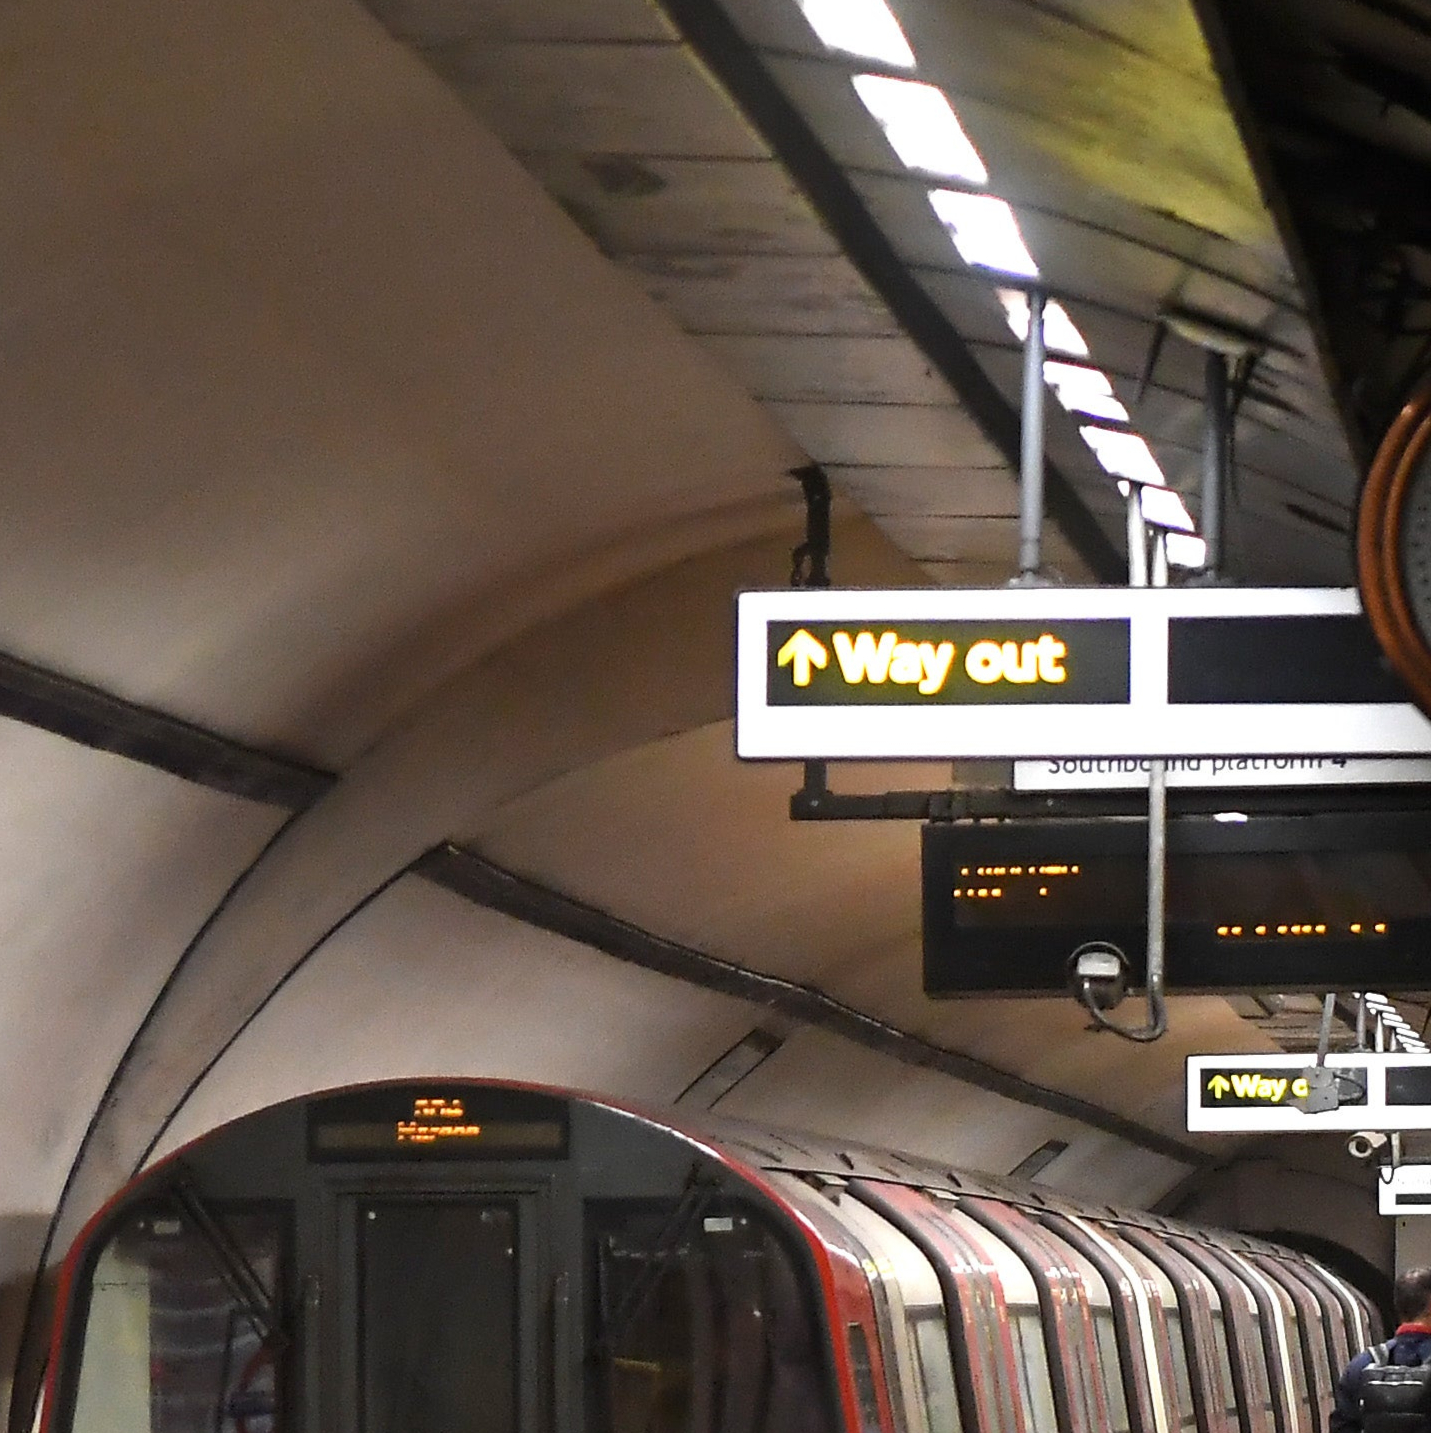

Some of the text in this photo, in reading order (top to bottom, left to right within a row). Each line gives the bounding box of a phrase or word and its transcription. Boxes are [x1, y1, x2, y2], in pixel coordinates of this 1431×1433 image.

[831, 629, 1068, 696] Way out
[1230, 1073, 1288, 1103] Way
